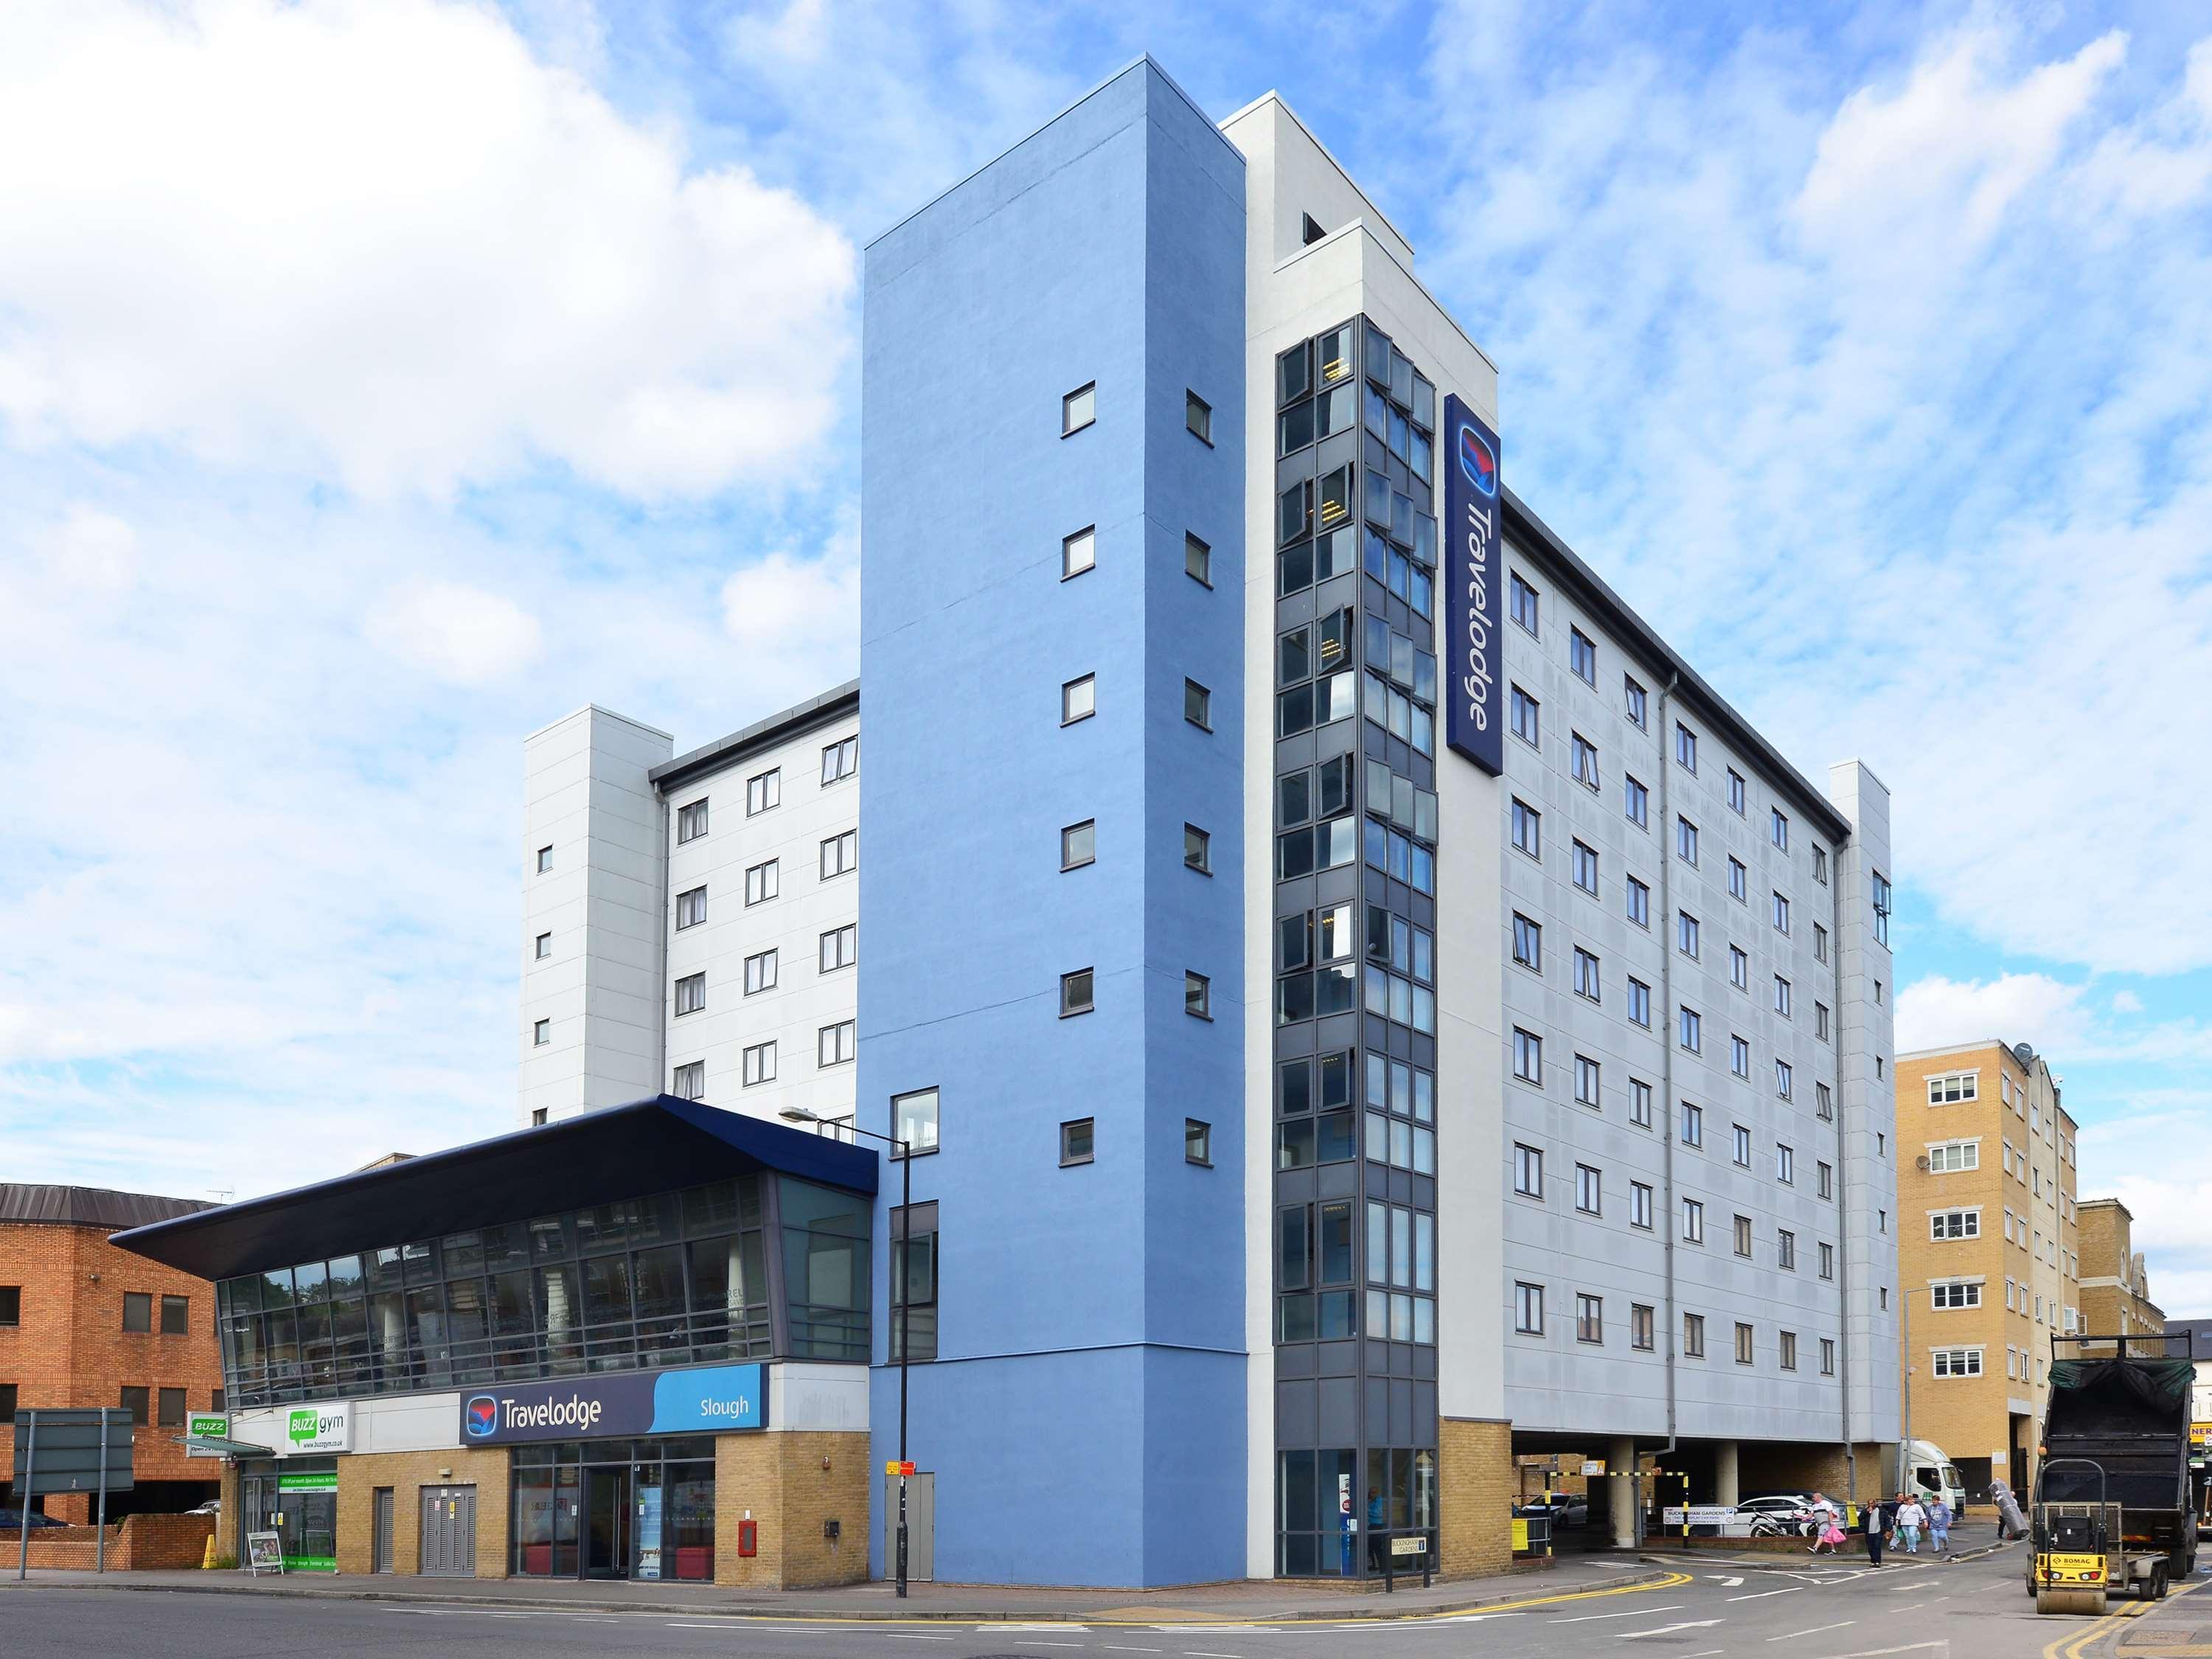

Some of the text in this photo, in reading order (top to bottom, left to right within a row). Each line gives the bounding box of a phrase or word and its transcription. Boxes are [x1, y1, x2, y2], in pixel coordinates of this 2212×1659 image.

[1464, 503, 1493, 731] Travelodge
[501, 1394, 602, 1430] Travelodge
[700, 1395, 748, 1419] Slough
[195, 1422, 224, 1430] BUZZ
[291, 1415, 344, 1433] BUZZ gym
[303, 1440, 343, 1448] www.buzzgym.co.uk
